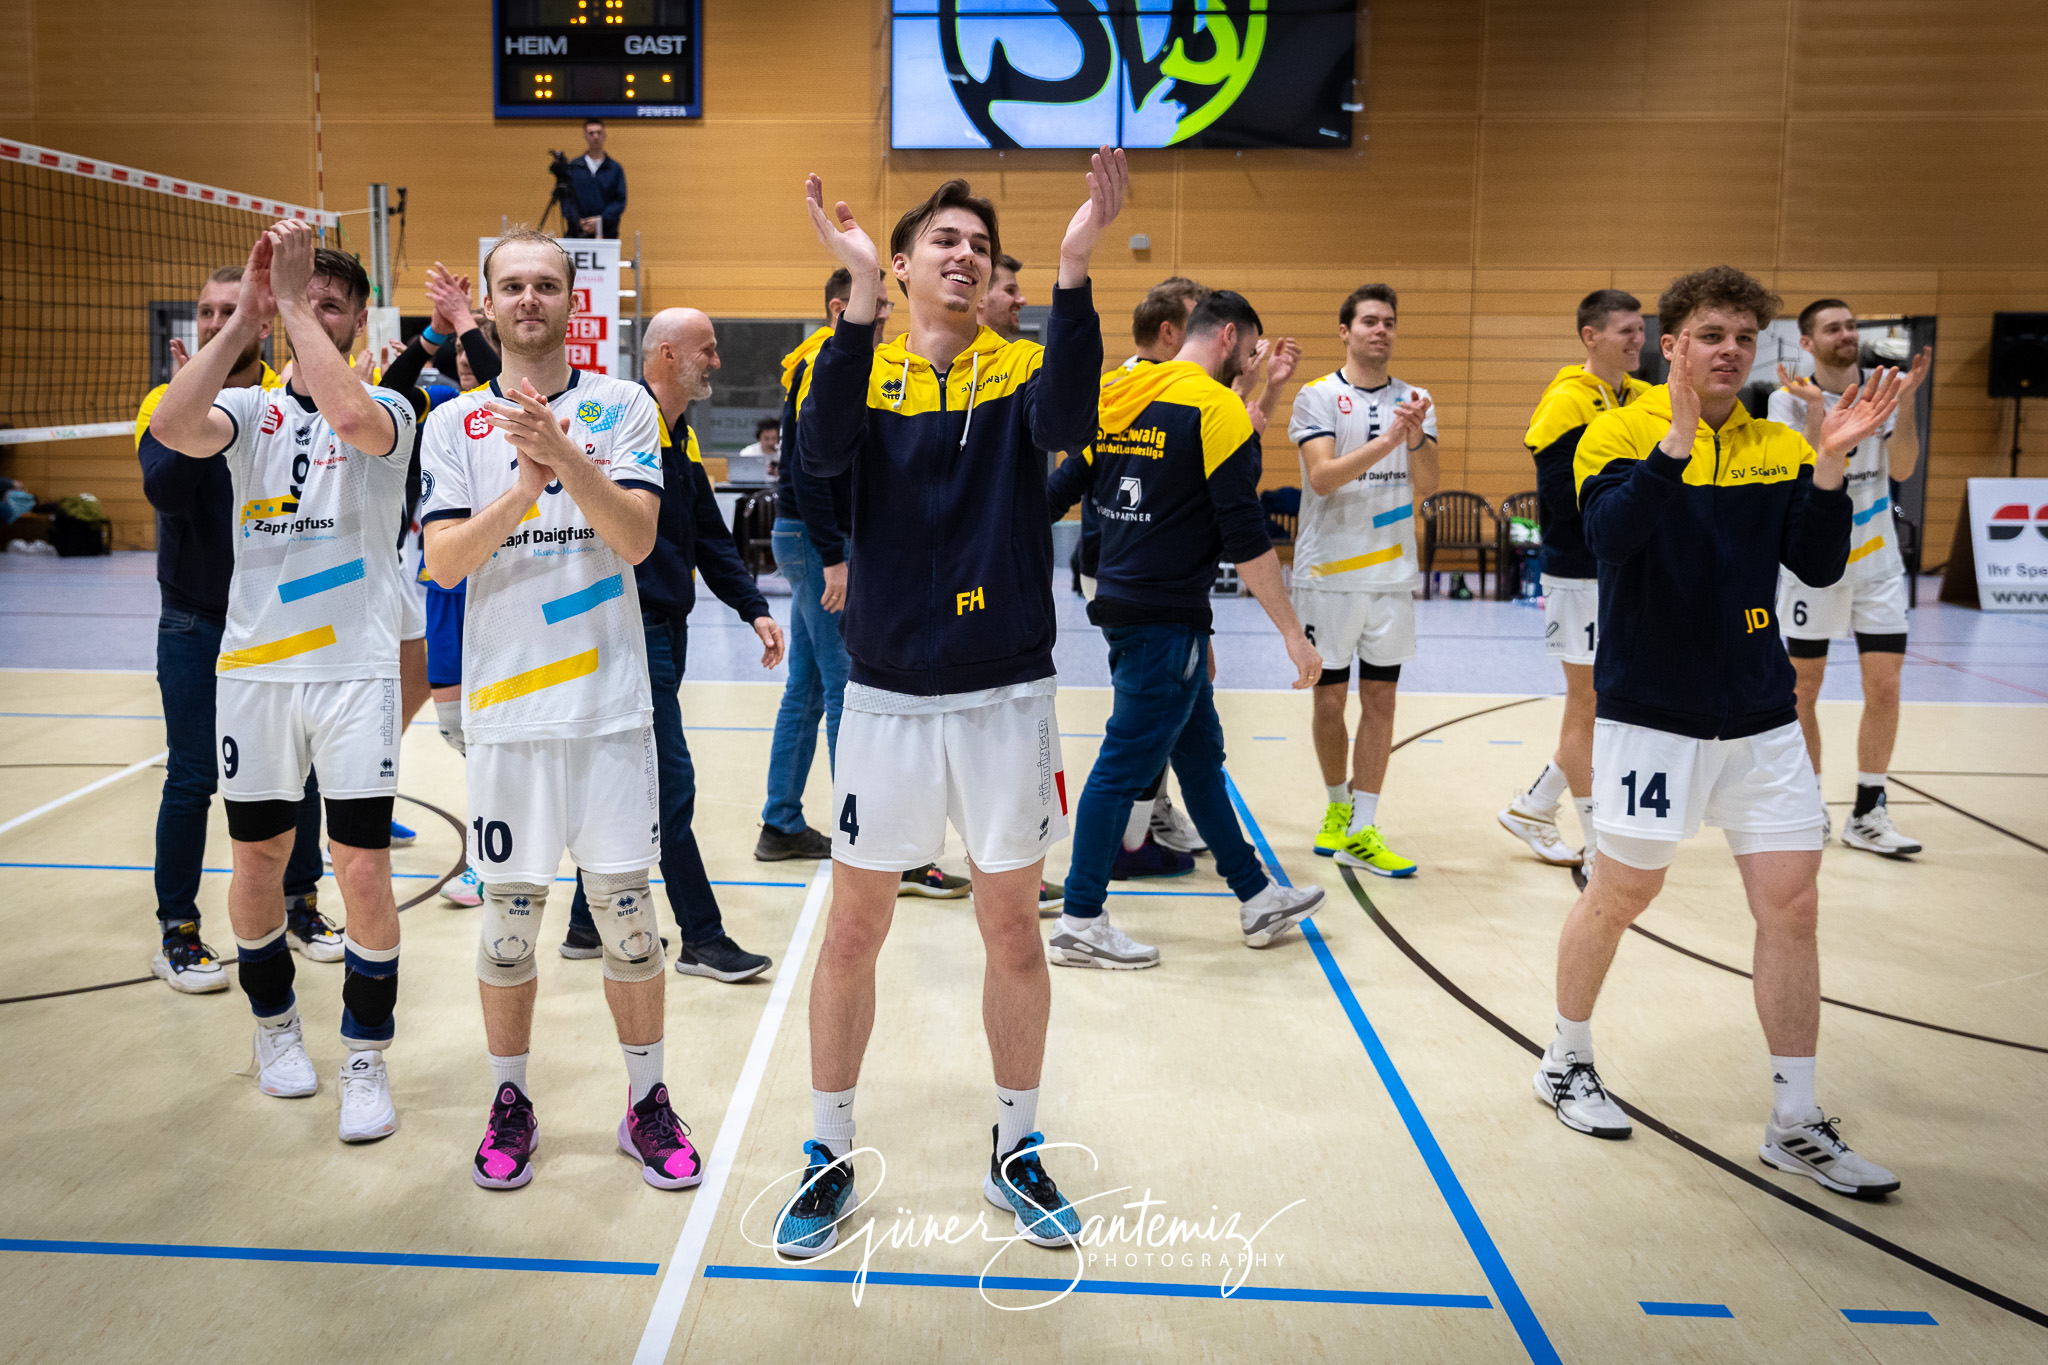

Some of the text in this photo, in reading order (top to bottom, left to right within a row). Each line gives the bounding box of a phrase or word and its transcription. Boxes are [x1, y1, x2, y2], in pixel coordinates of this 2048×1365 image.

[505, 35, 687, 55] HEIM GAST
[290, 453, 310, 500] 9
[1731, 468, 1745, 479] SV
[254, 520, 288, 536] Zapf
[533, 527, 595, 544] Daigfuss
[1987, 564, 2010, 577] Ihr
[956, 586, 985, 616] FH
[1793, 600, 1808, 626] 6
[1745, 607, 1770, 634] JD
[222, 735, 239, 780] 9
[1621, 770, 1671, 818] 14
[839, 793, 859, 846] 4
[473, 816, 513, 863] 10
[509, 908, 530, 916] errea
[617, 906, 639, 918] errea
